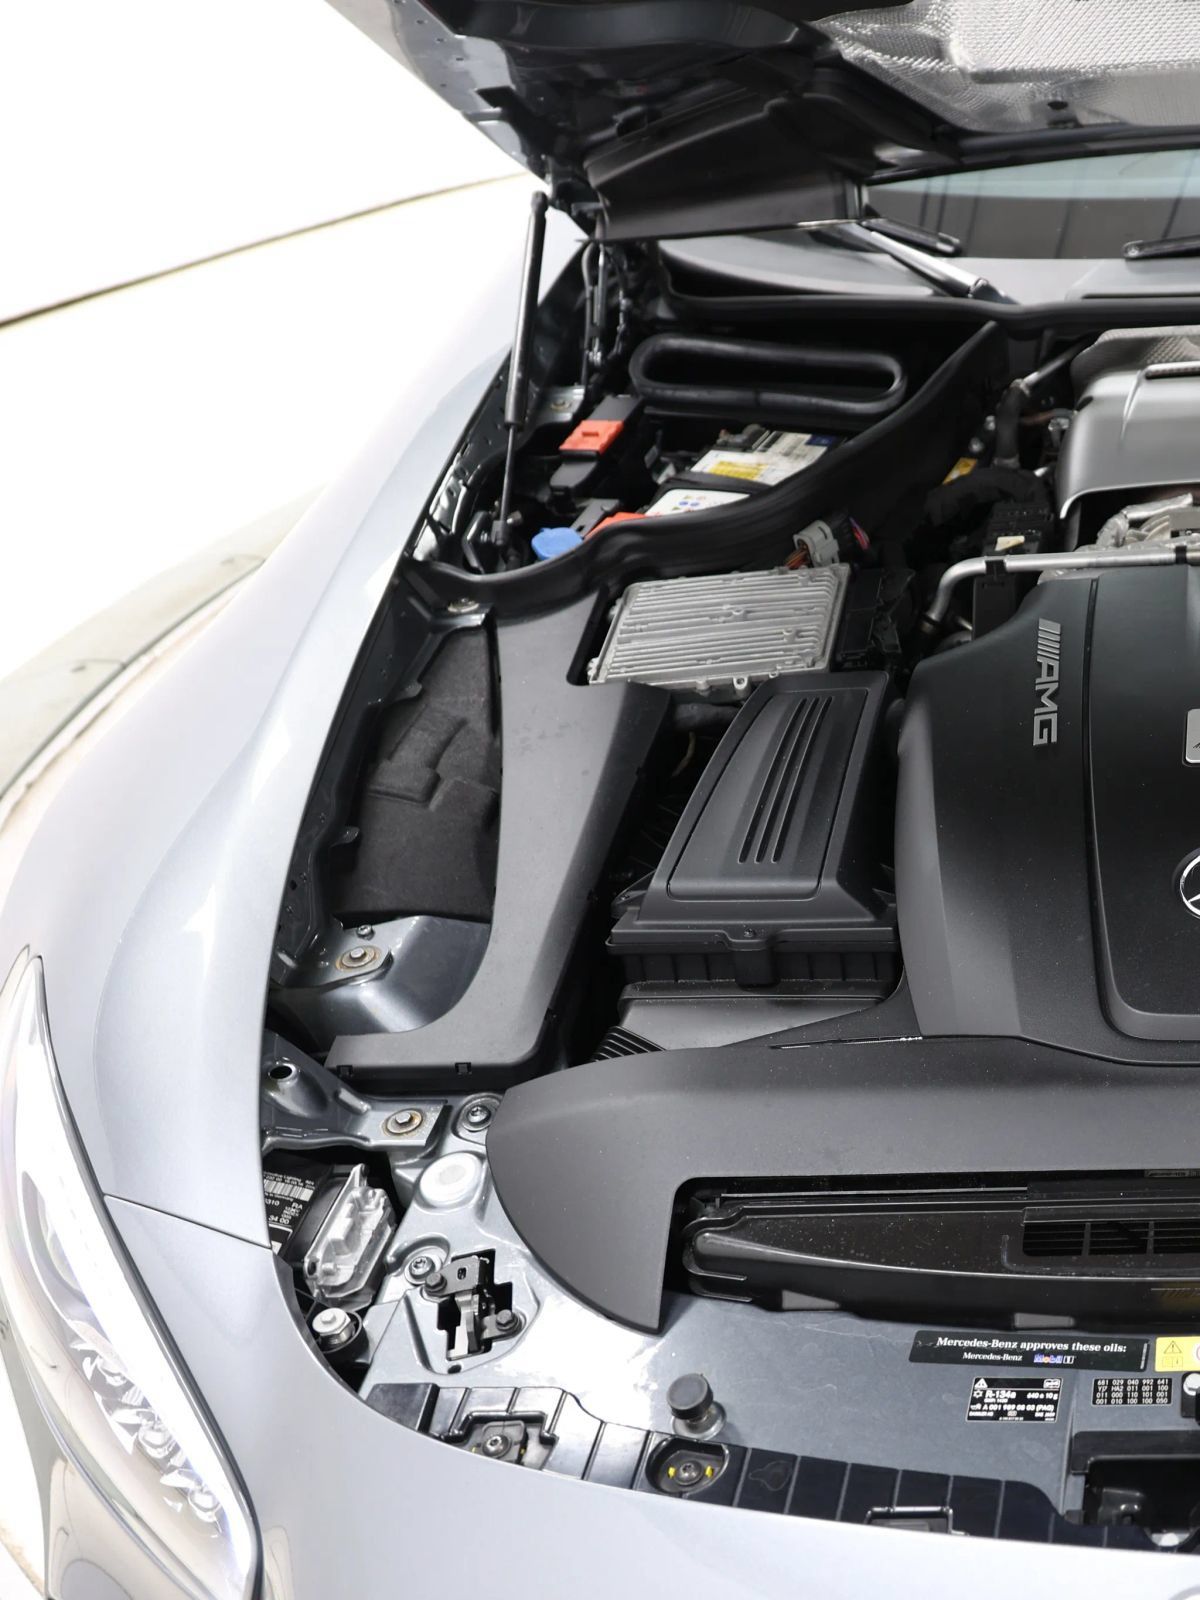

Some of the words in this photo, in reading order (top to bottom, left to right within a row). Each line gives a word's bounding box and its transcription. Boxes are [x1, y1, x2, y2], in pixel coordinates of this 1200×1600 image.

[936, 1336, 1018, 1349] Mercedes-Benz
[1019, 1342, 1069, 1351] approves
[1071, 1341, 1102, 1352] these
[1103, 1343, 1127, 1353] oils:
[963, 1352, 1023, 1362] Mercedes-Benz
